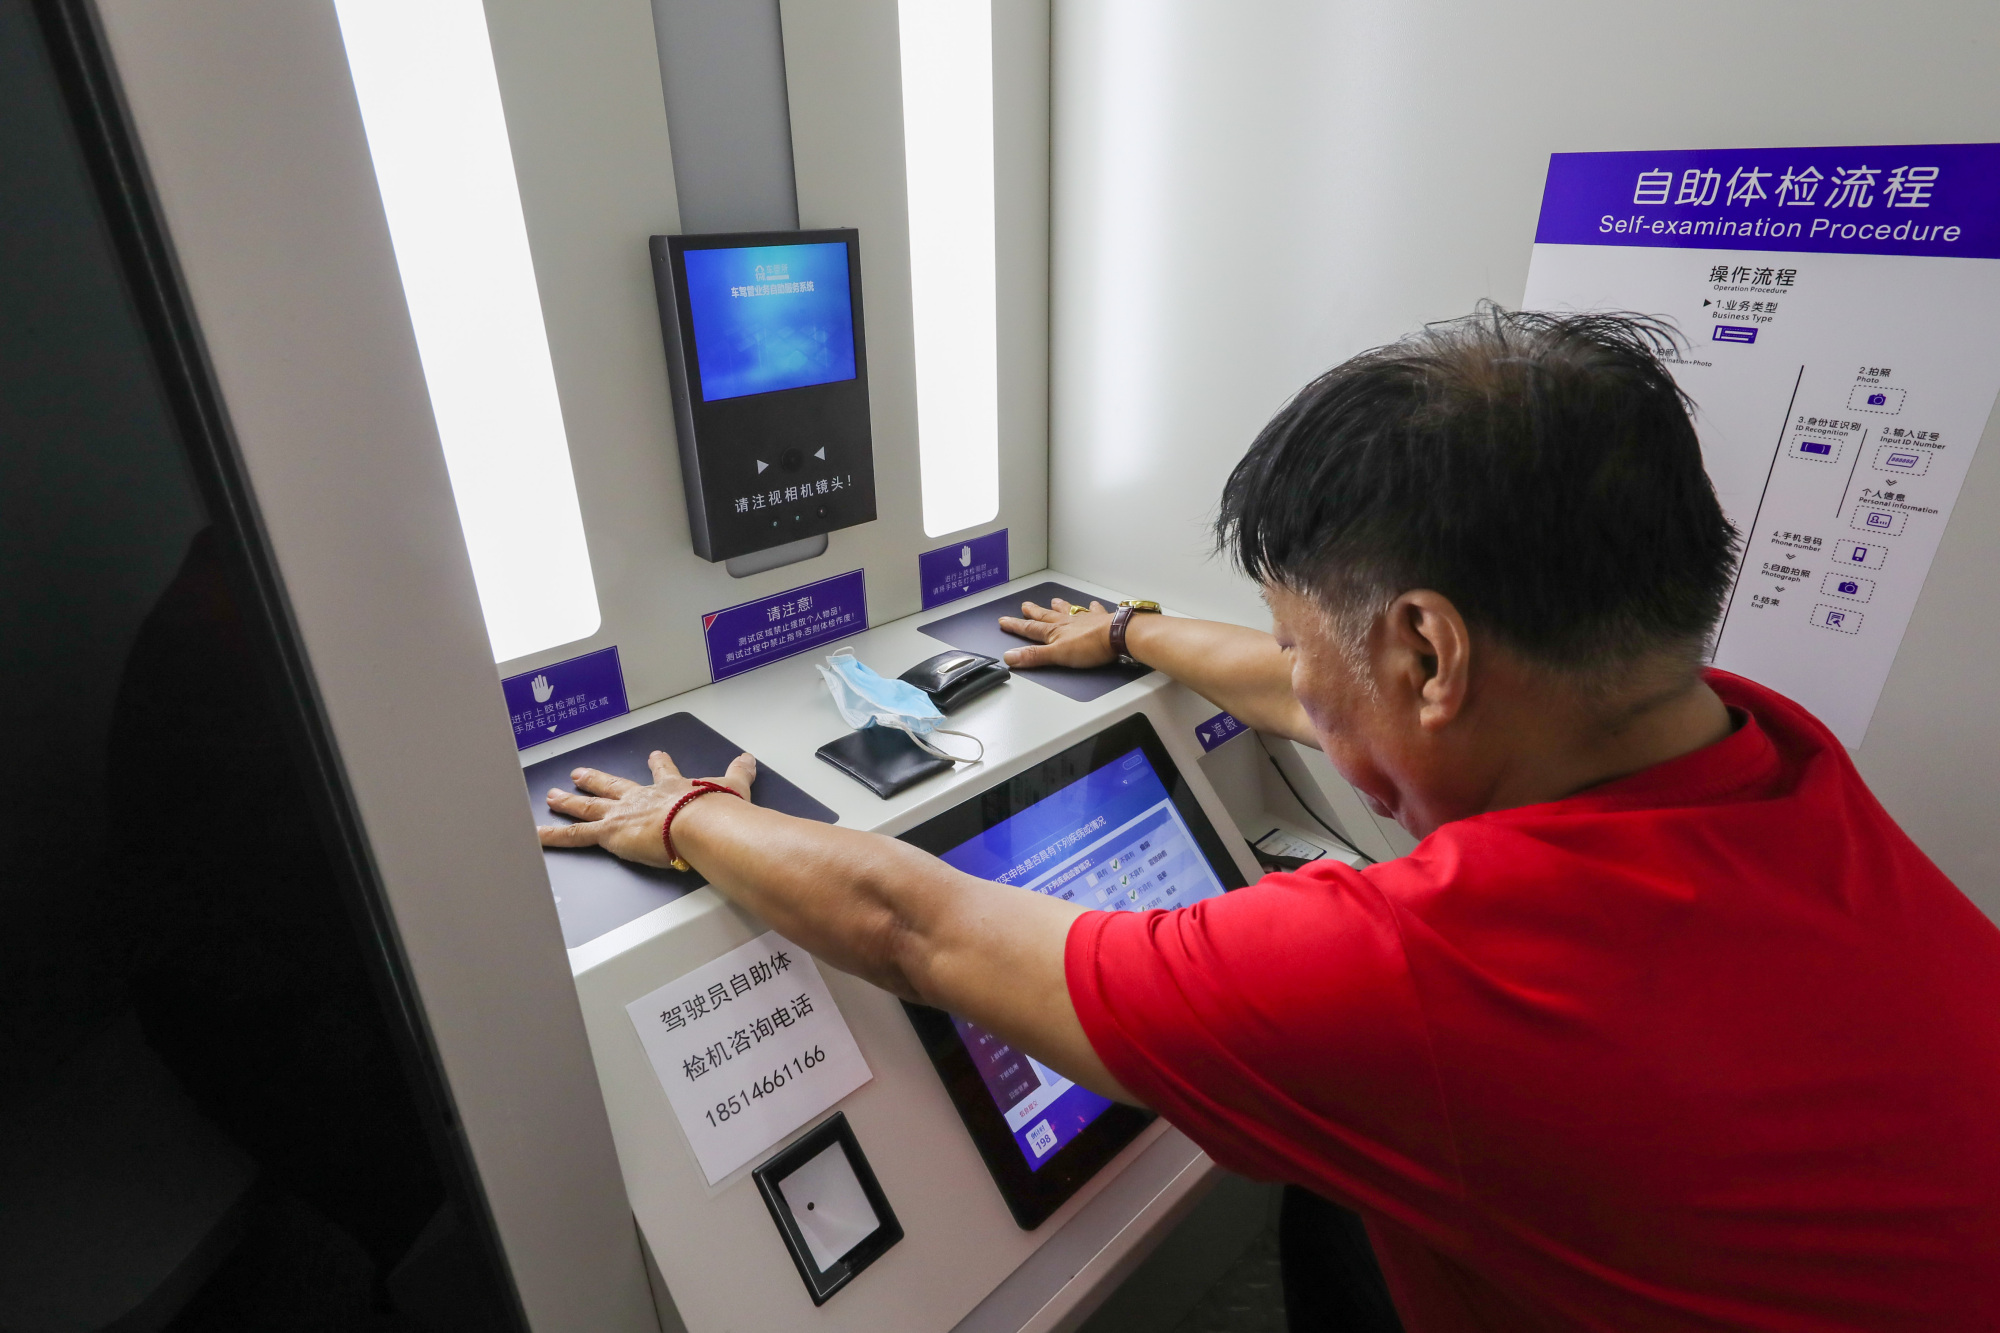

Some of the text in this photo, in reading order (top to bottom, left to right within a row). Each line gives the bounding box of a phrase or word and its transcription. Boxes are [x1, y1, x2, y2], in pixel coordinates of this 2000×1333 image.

[1633, 165, 1940, 208] 自助体检流程
[1599, 215, 1961, 242] Self-examination Procedure
[1708, 265, 1797, 287] 操作流程
[731, 281, 814, 298] 车驾管业务自助服务系统
[1713, 284, 1787, 294] Operation Procedure
[1716, 299, 1778, 313] 1.业务类型
[1712, 311, 1773, 323] Business Type
[1856, 376, 1879, 384] Photo
[1858, 366, 1892, 378] 2.拍照
[1795, 424, 1849, 437] ID Recognition
[1797, 416, 1862, 432] 3.身份证识别
[1882, 426, 1940, 442] 3.输入证号
[1880, 436, 1946, 450] Input ID Number
[1861, 488, 1906, 503] 个人信息
[1858, 496, 1938, 515] Personal information
[1771, 538, 1821, 552] Phone number
[1773, 530, 1823, 547] 4.手机号码
[1761, 570, 1801, 583] Photograph
[1763, 562, 1811, 579] 5.自助拍照
[1751, 601, 1764, 610] End
[1753, 594, 1780, 607] 6.结束
[660, 950, 792, 1033] 驾驶员自助体
[682, 993, 815, 1082] 检机咨询电话
[705, 1044, 826, 1128] 18514661166
[1035, 1134, 1052, 1151] 198
